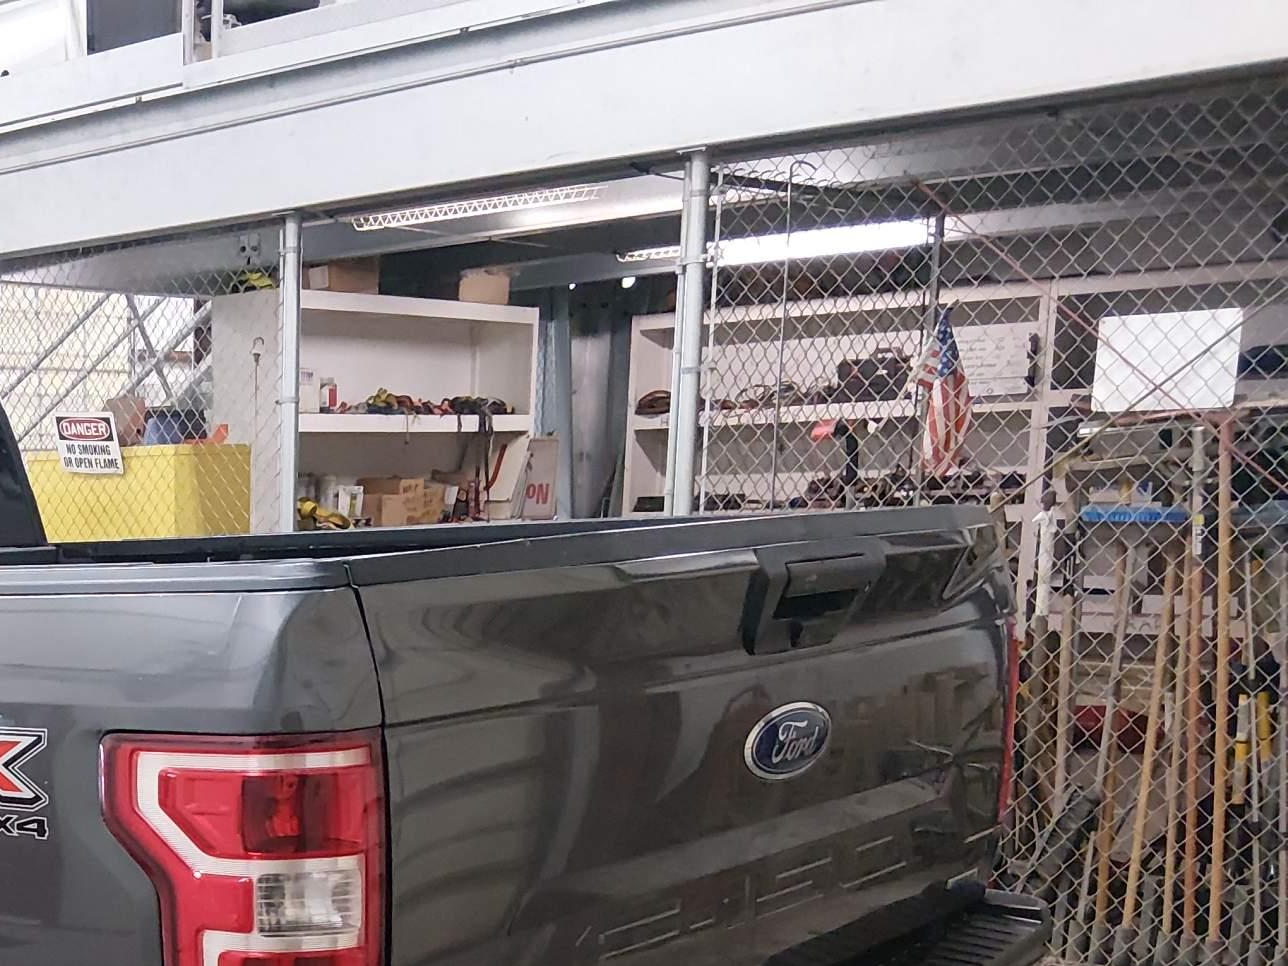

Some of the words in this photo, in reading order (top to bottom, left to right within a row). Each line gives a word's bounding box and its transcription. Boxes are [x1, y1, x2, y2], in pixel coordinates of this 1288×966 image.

[62, 422, 107, 436] DANGER
[66, 444, 76, 455] NO
[77, 444, 111, 456] SMOKING
[63, 457, 74, 467] OR
[75, 457, 93, 468] OPEN
[94, 458, 120, 469] FLAME
